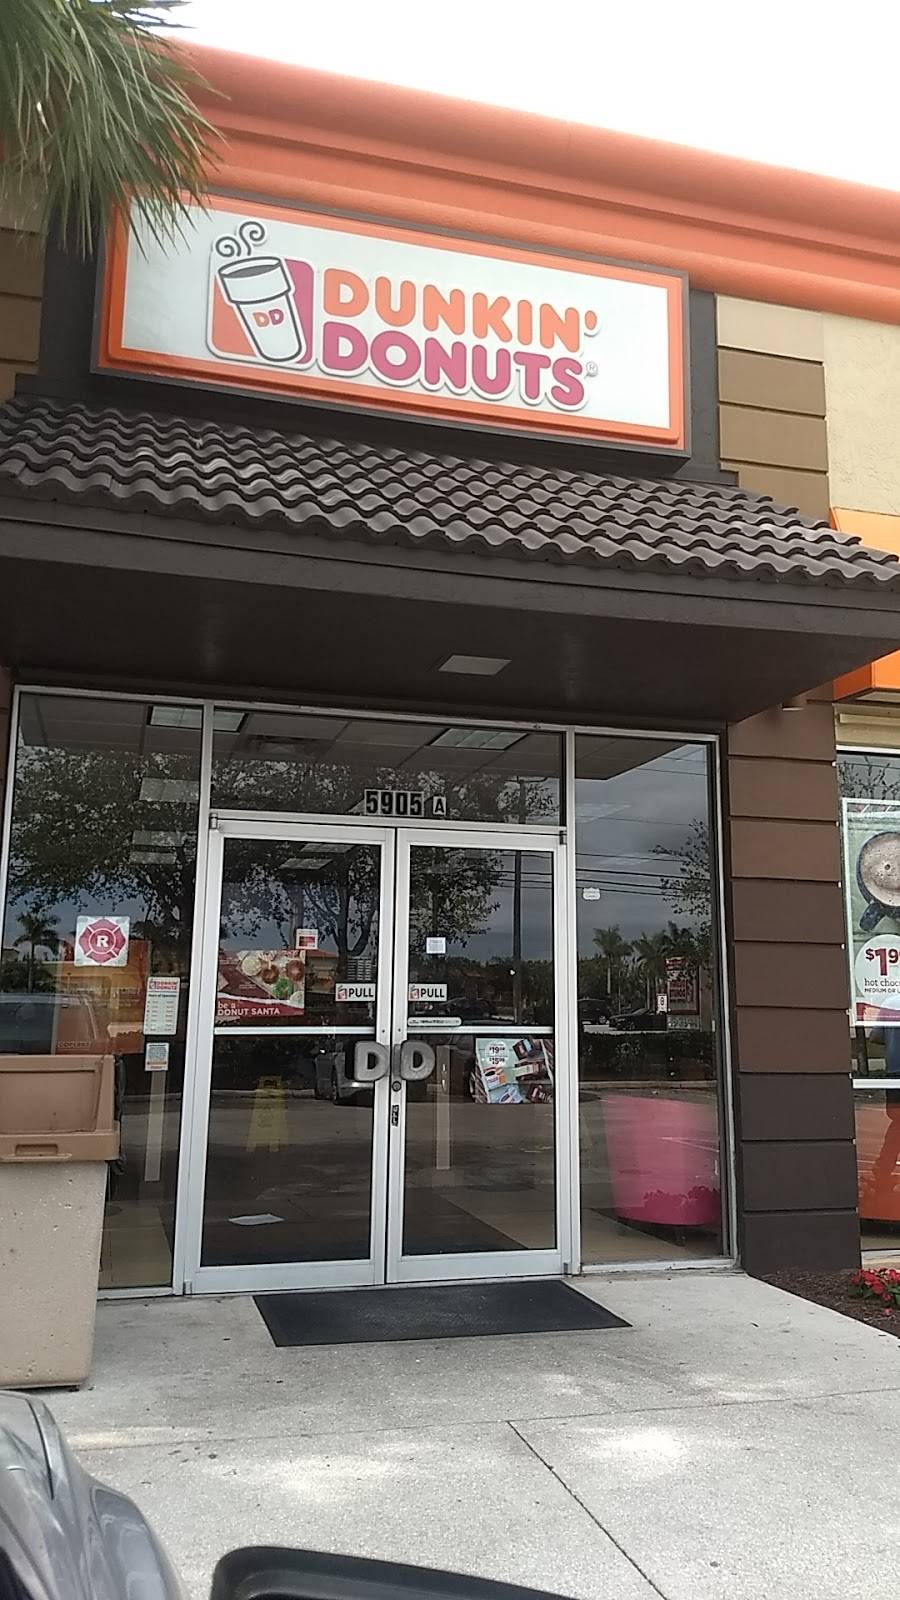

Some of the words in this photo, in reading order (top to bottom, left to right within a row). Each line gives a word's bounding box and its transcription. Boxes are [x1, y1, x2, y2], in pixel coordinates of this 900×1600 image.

[323, 268, 598, 353] DUNKIN'
[252, 308, 285, 328] DD
[322, 321, 585, 406] DONUTS
[366, 791, 423, 815] 5905
[434, 798, 445, 813] A
[96, 935, 109, 948] R
[865, 948, 900, 976] $19
[864, 978, 878, 987] hot
[880, 978, 900, 987] choc
[348, 988, 373, 998] PULL
[420, 988, 445, 998] PULL
[217, 1001, 228, 1009] be
[217, 1008, 250, 1016] DONUT
